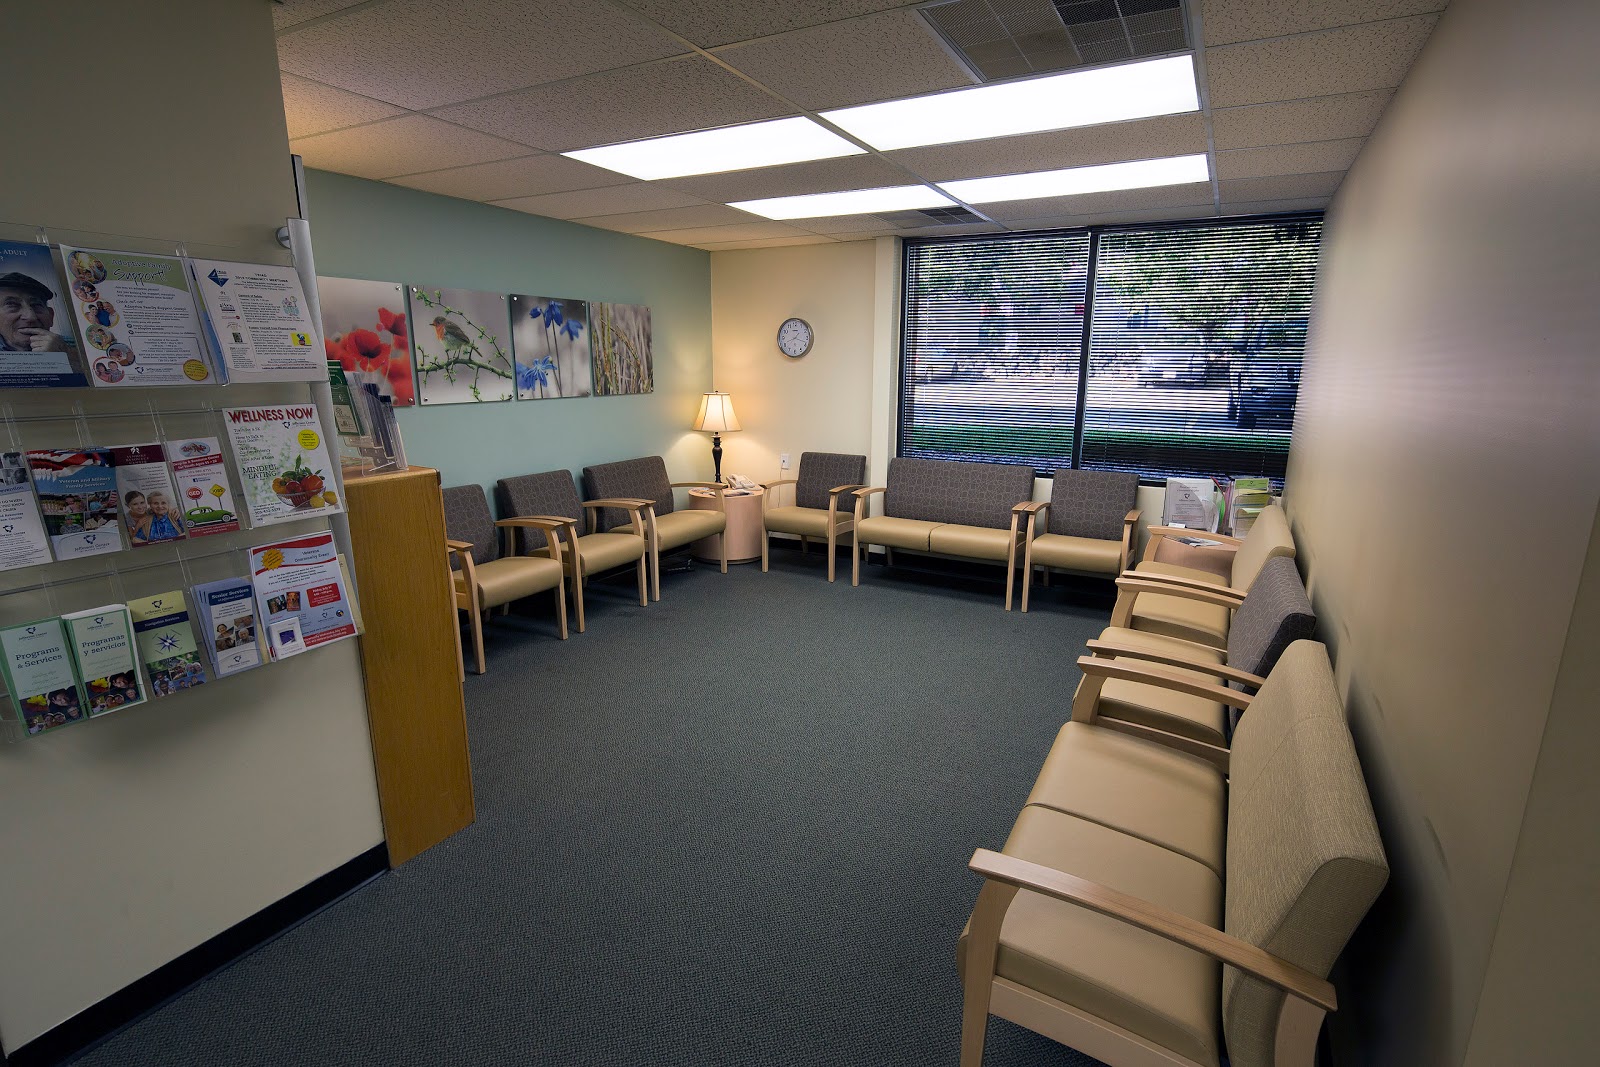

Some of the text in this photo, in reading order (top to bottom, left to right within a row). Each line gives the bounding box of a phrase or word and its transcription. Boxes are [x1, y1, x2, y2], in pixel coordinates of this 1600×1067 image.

[3, 249, 28, 257] ADULT
[112, 259, 173, 272] Adoptive Family
[228, 407, 314, 423] WELLNESS NOW
[242, 464, 279, 474] MINDFUL
[248, 470, 277, 479] EATING
[294, 554, 319, 564] Community
[211, 588, 250, 600] Senior Services
[164, 615, 180, 624] Services
[81, 634, 126, 649] Programas
[15, 645, 60, 662] Programs
[91, 641, 127, 655] servicios
[24, 653, 63, 668] Services
